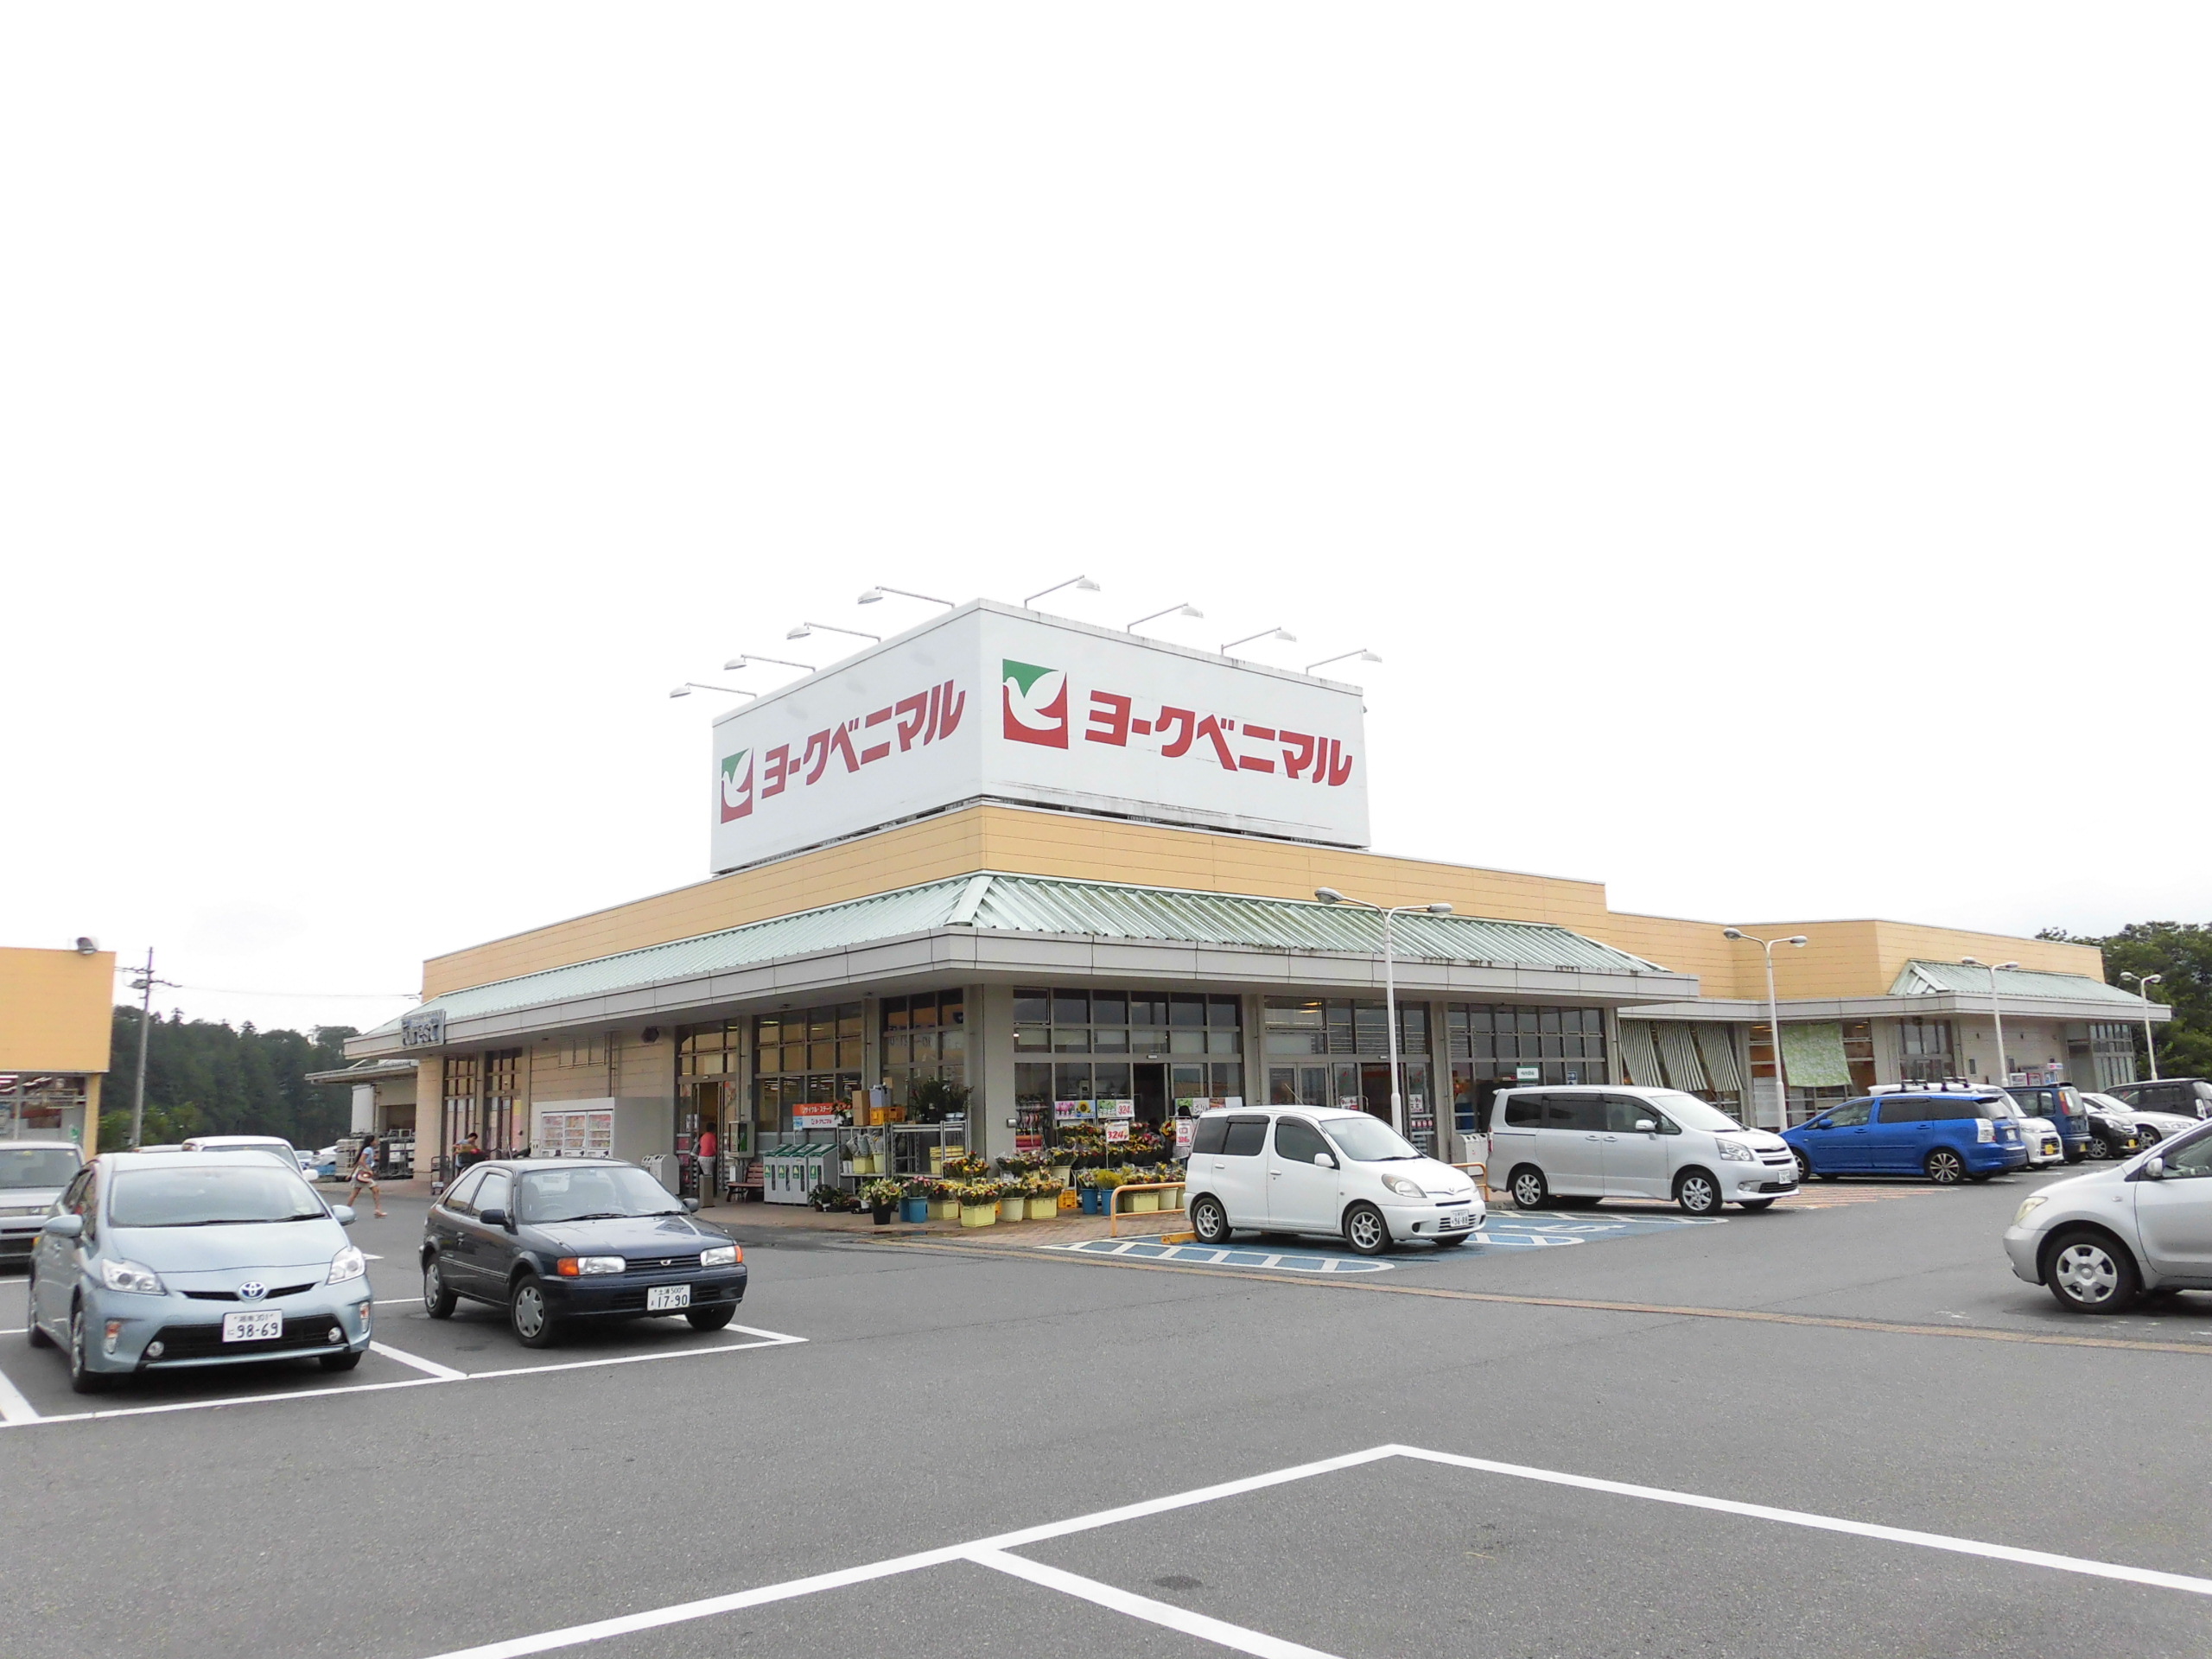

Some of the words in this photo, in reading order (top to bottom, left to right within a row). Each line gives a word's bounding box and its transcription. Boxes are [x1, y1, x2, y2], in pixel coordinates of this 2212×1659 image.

[762, 679, 965, 798] ヨークベニマル
[1085, 690, 1353, 786] ヨークベニマル
[658, 1294, 688, 1308] 17-90
[237, 1322, 278, 1338] 98-69
